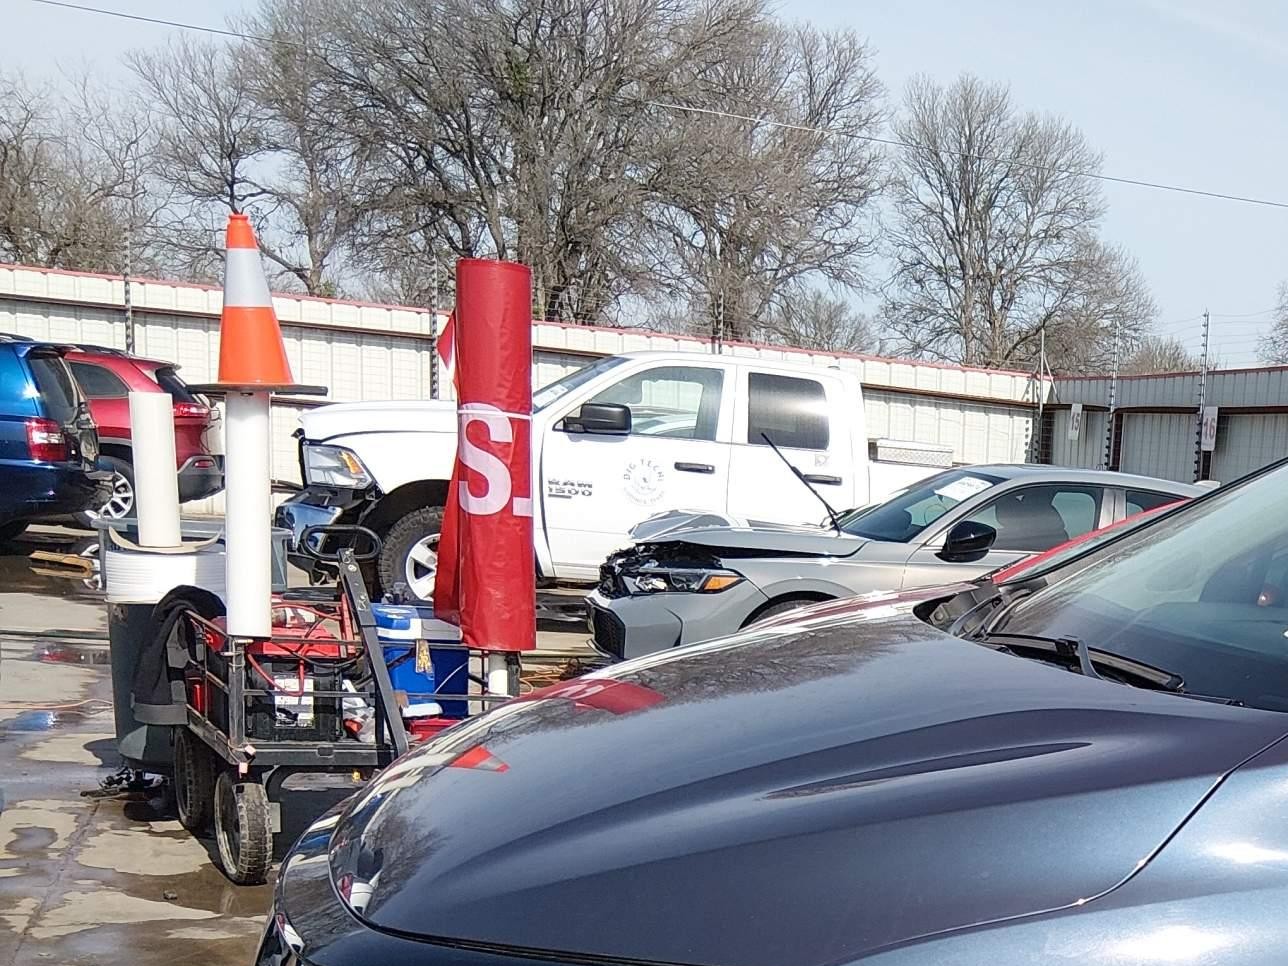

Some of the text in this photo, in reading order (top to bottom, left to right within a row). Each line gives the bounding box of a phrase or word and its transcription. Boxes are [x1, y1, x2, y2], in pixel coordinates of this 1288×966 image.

[1071, 413, 1081, 431] 15
[1203, 417, 1216, 440] 16
[547, 486, 593, 497] 1500
